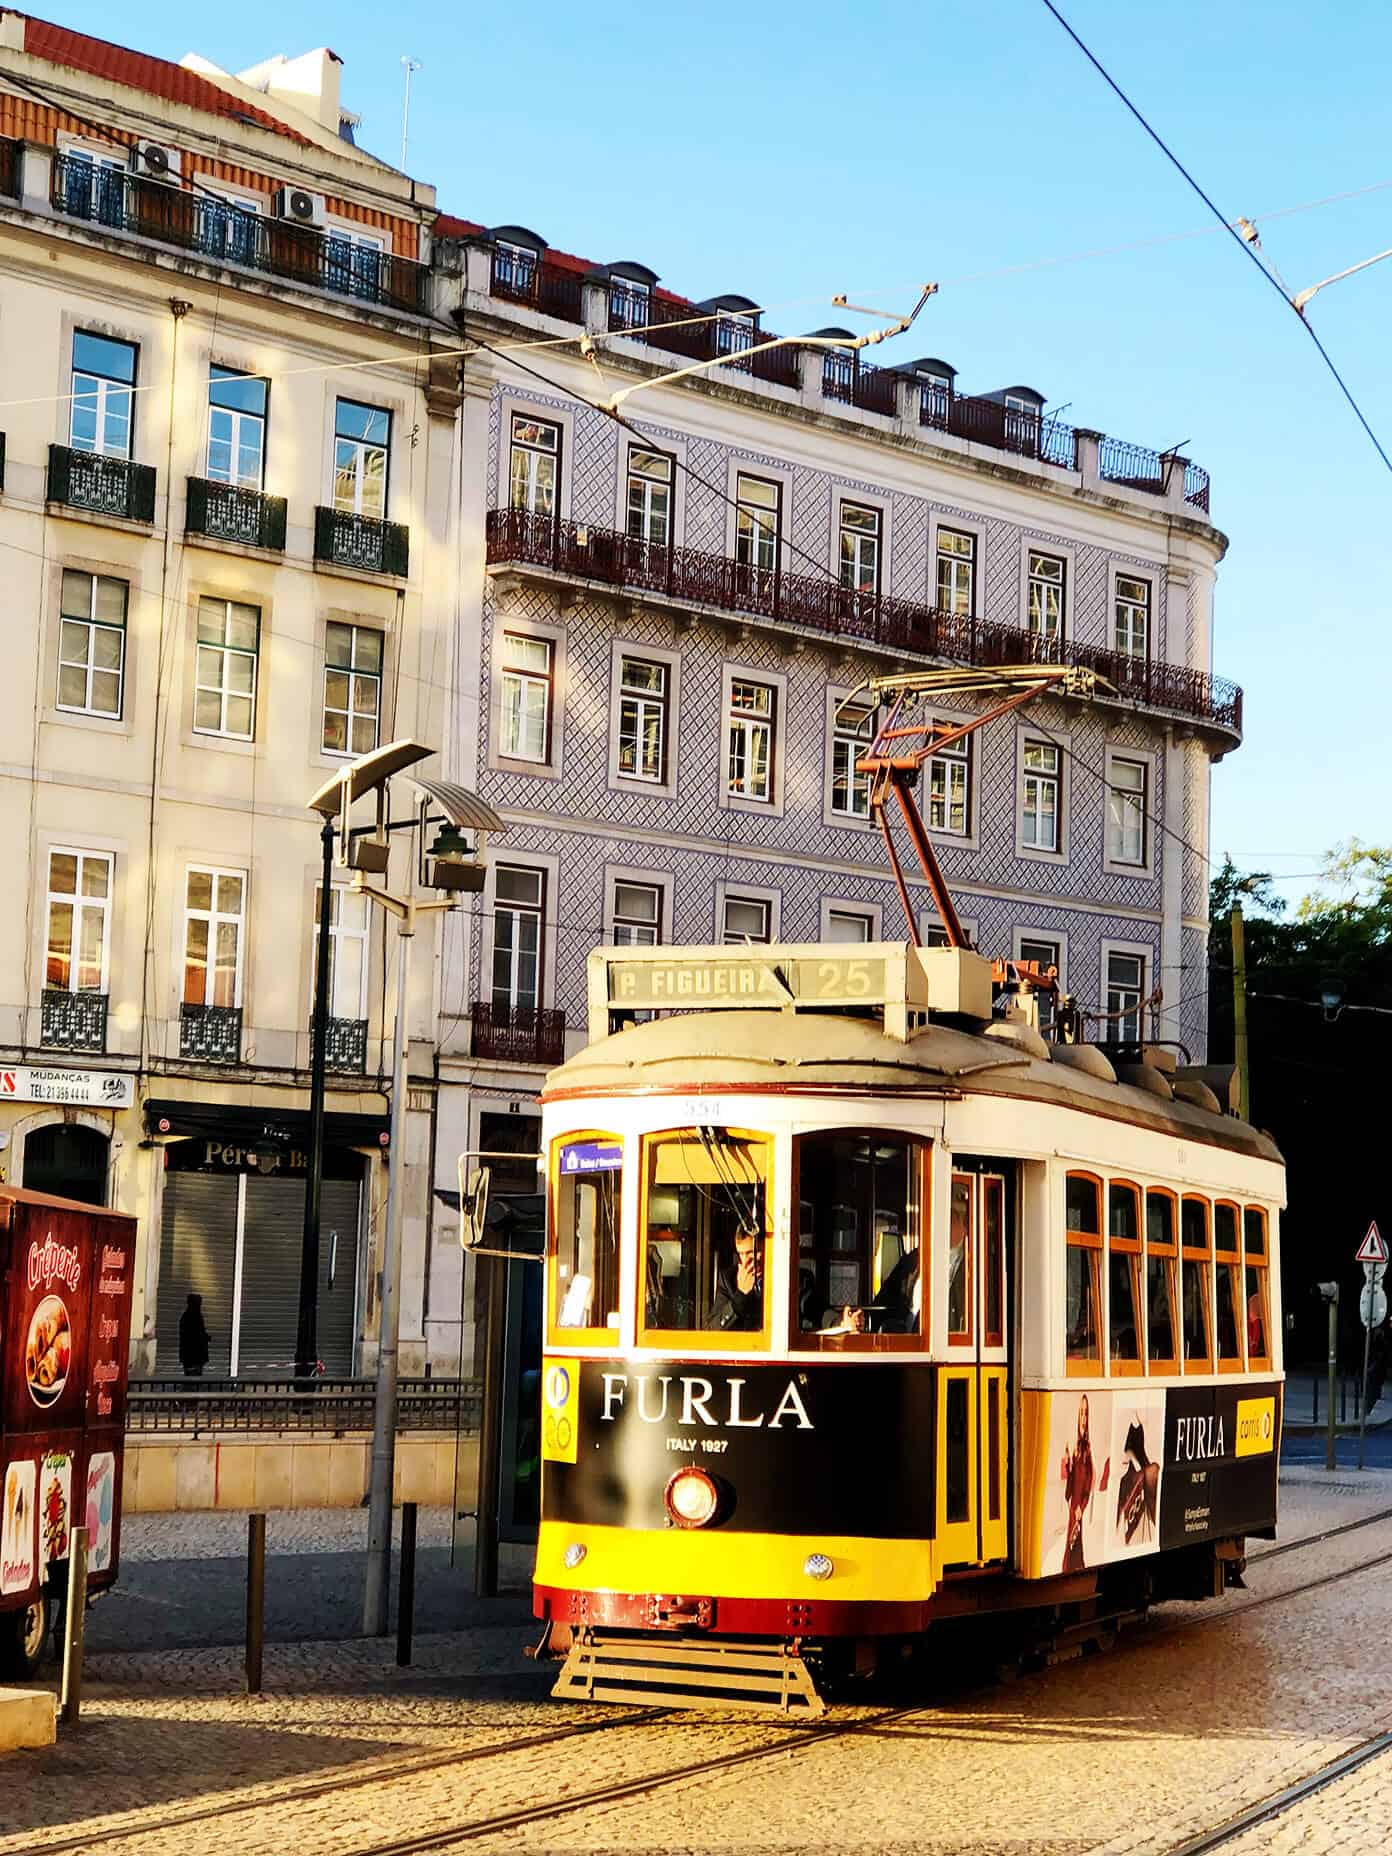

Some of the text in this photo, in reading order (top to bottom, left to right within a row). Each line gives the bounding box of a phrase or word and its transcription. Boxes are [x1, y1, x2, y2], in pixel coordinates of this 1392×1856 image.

[620, 972, 637, 996] P.
[817, 961, 871, 997] 25
[30, 1071, 90, 1083] MUDANÇAS
[601, 1373, 815, 1429] FURLA
[666, 1438, 729, 1453] ITALY 1927
[1175, 1415, 1225, 1462] FURLA
